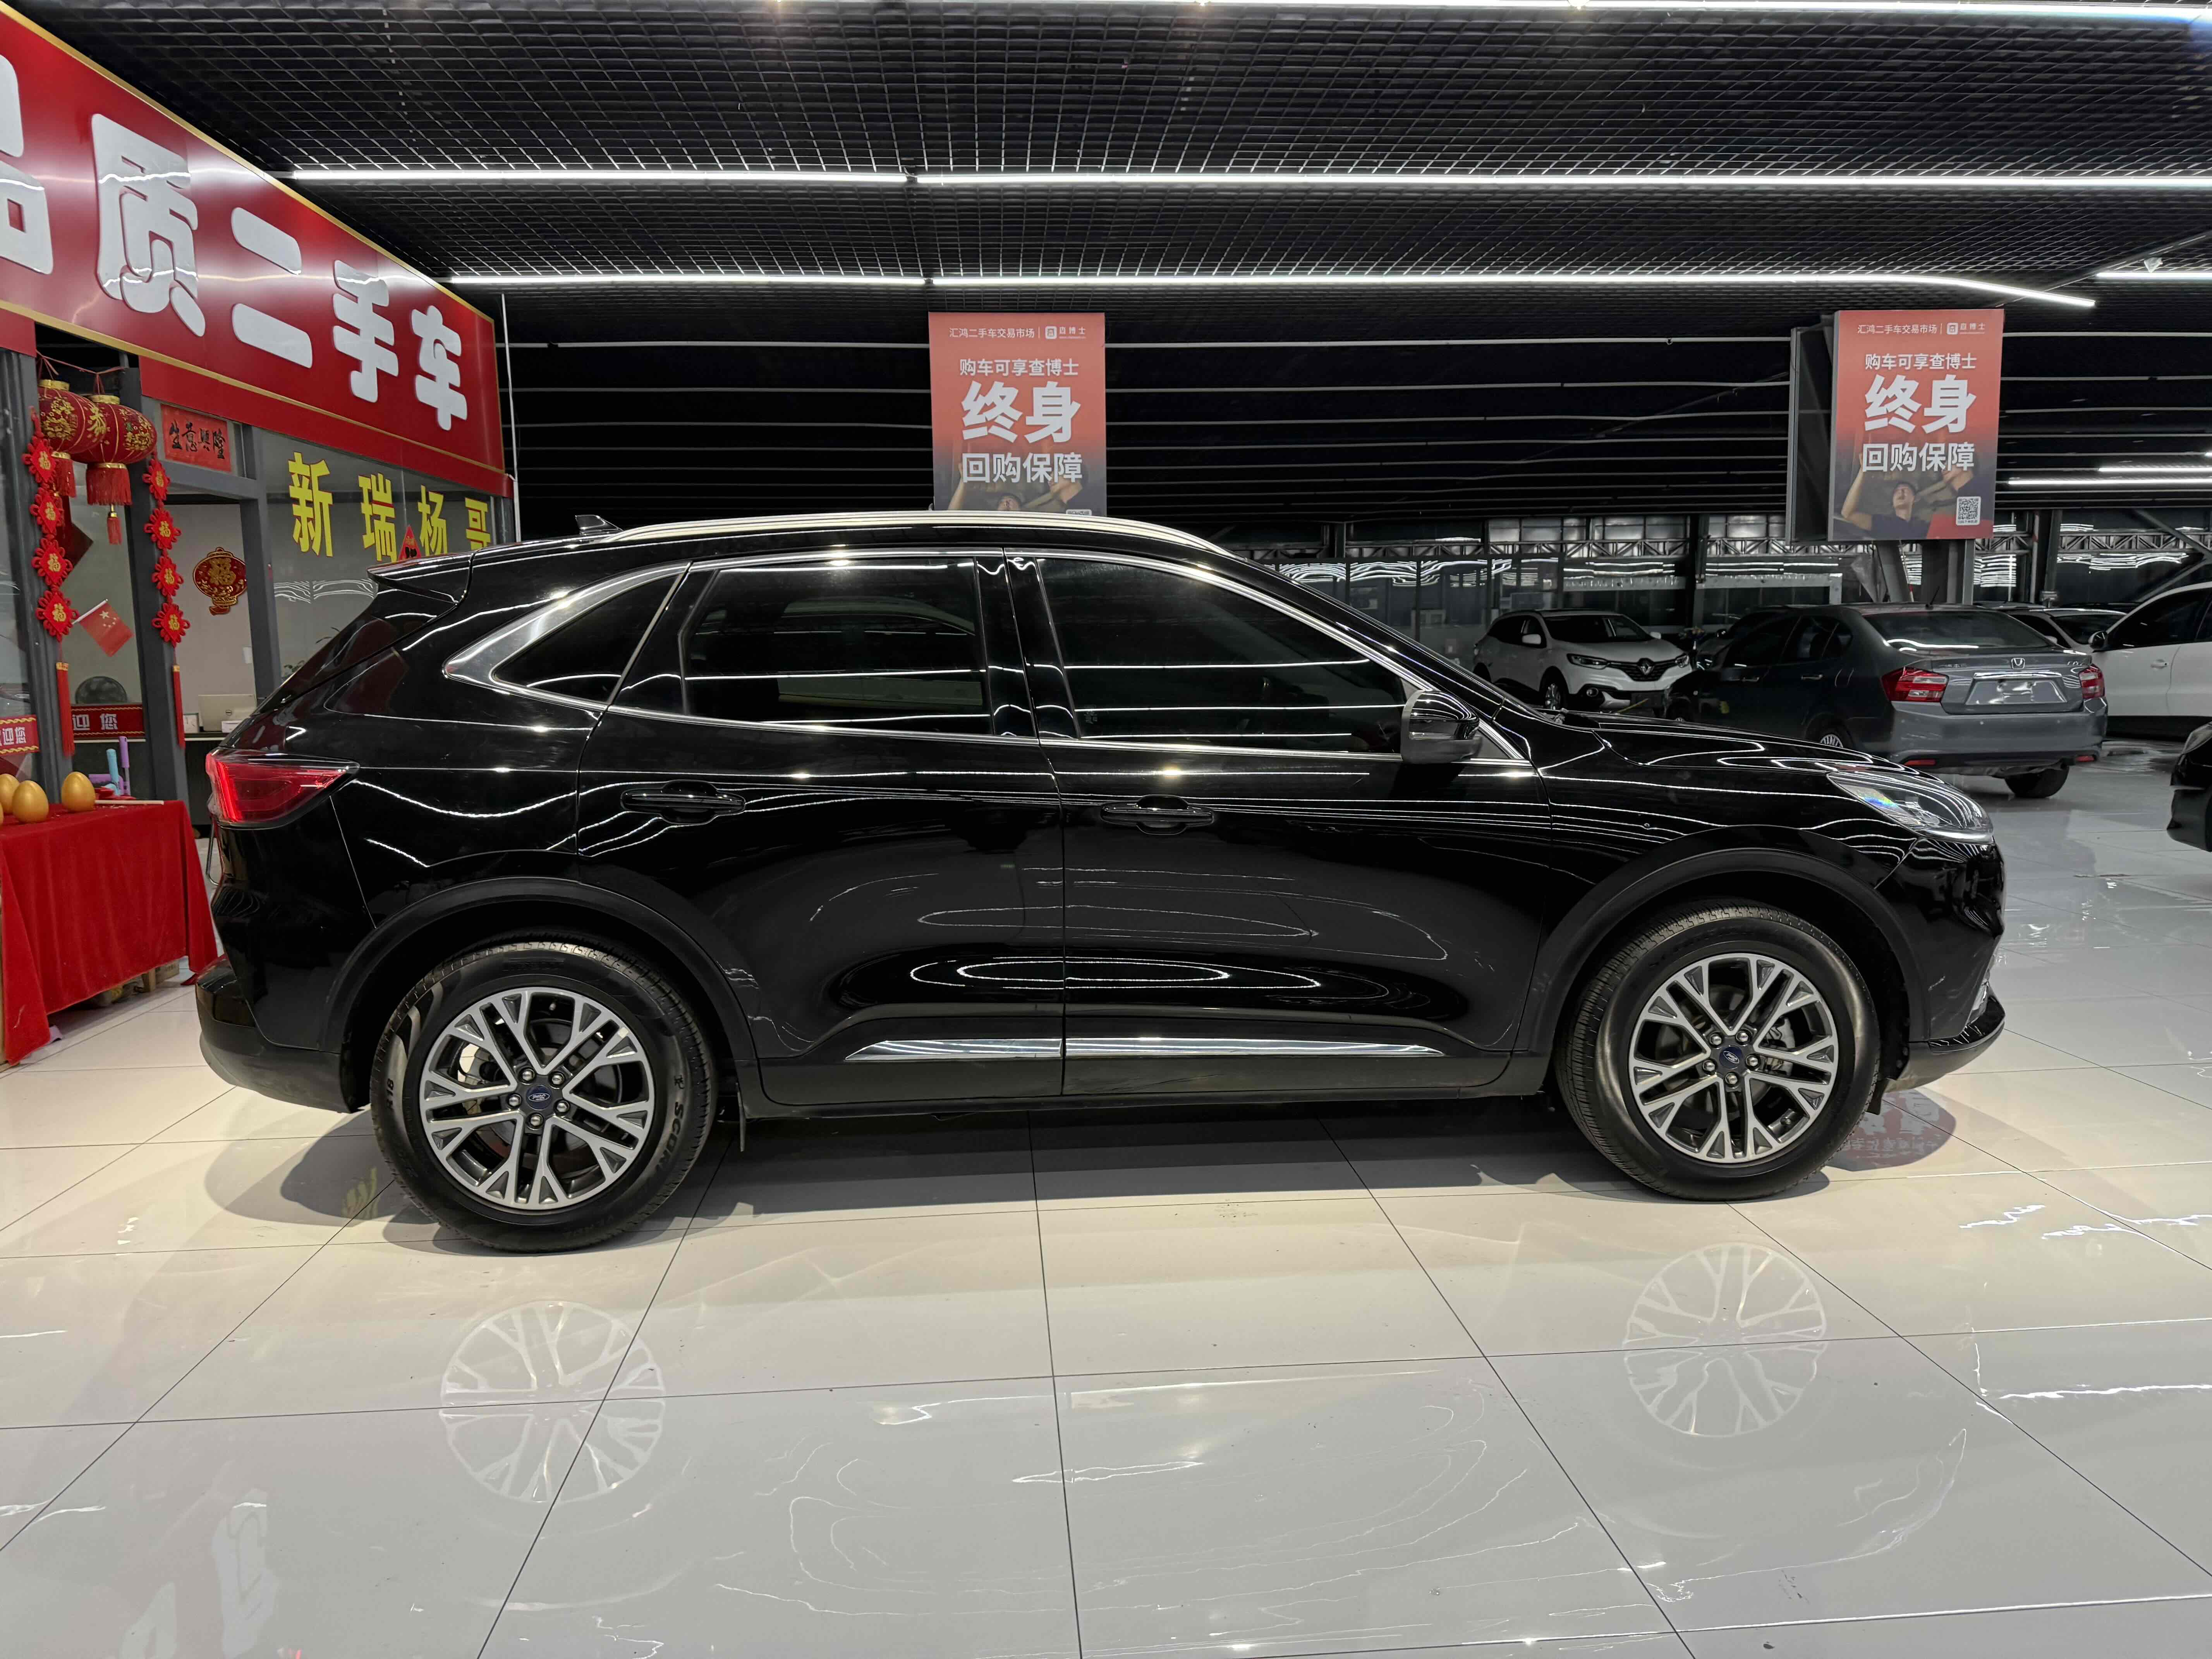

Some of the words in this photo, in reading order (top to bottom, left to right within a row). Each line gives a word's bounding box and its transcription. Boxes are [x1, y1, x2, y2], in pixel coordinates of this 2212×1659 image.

[950, 328, 1035, 338] 汇鸿二手车交易市场
[1858, 324, 1937, 334] 汇鸿二手车交易市场
[960, 359, 1079, 376] 购车可享查博士
[1865, 352, 1977, 370] 购车可享查博士
[961, 381, 1081, 443] 终身
[1865, 374, 1977, 434] 终身
[962, 452, 1082, 483] 回购保障
[1862, 441, 1975, 472] 回购保障
[288, 452, 491, 562] 新瑞杨哥
[0, 726, 26, 746] 迎您
